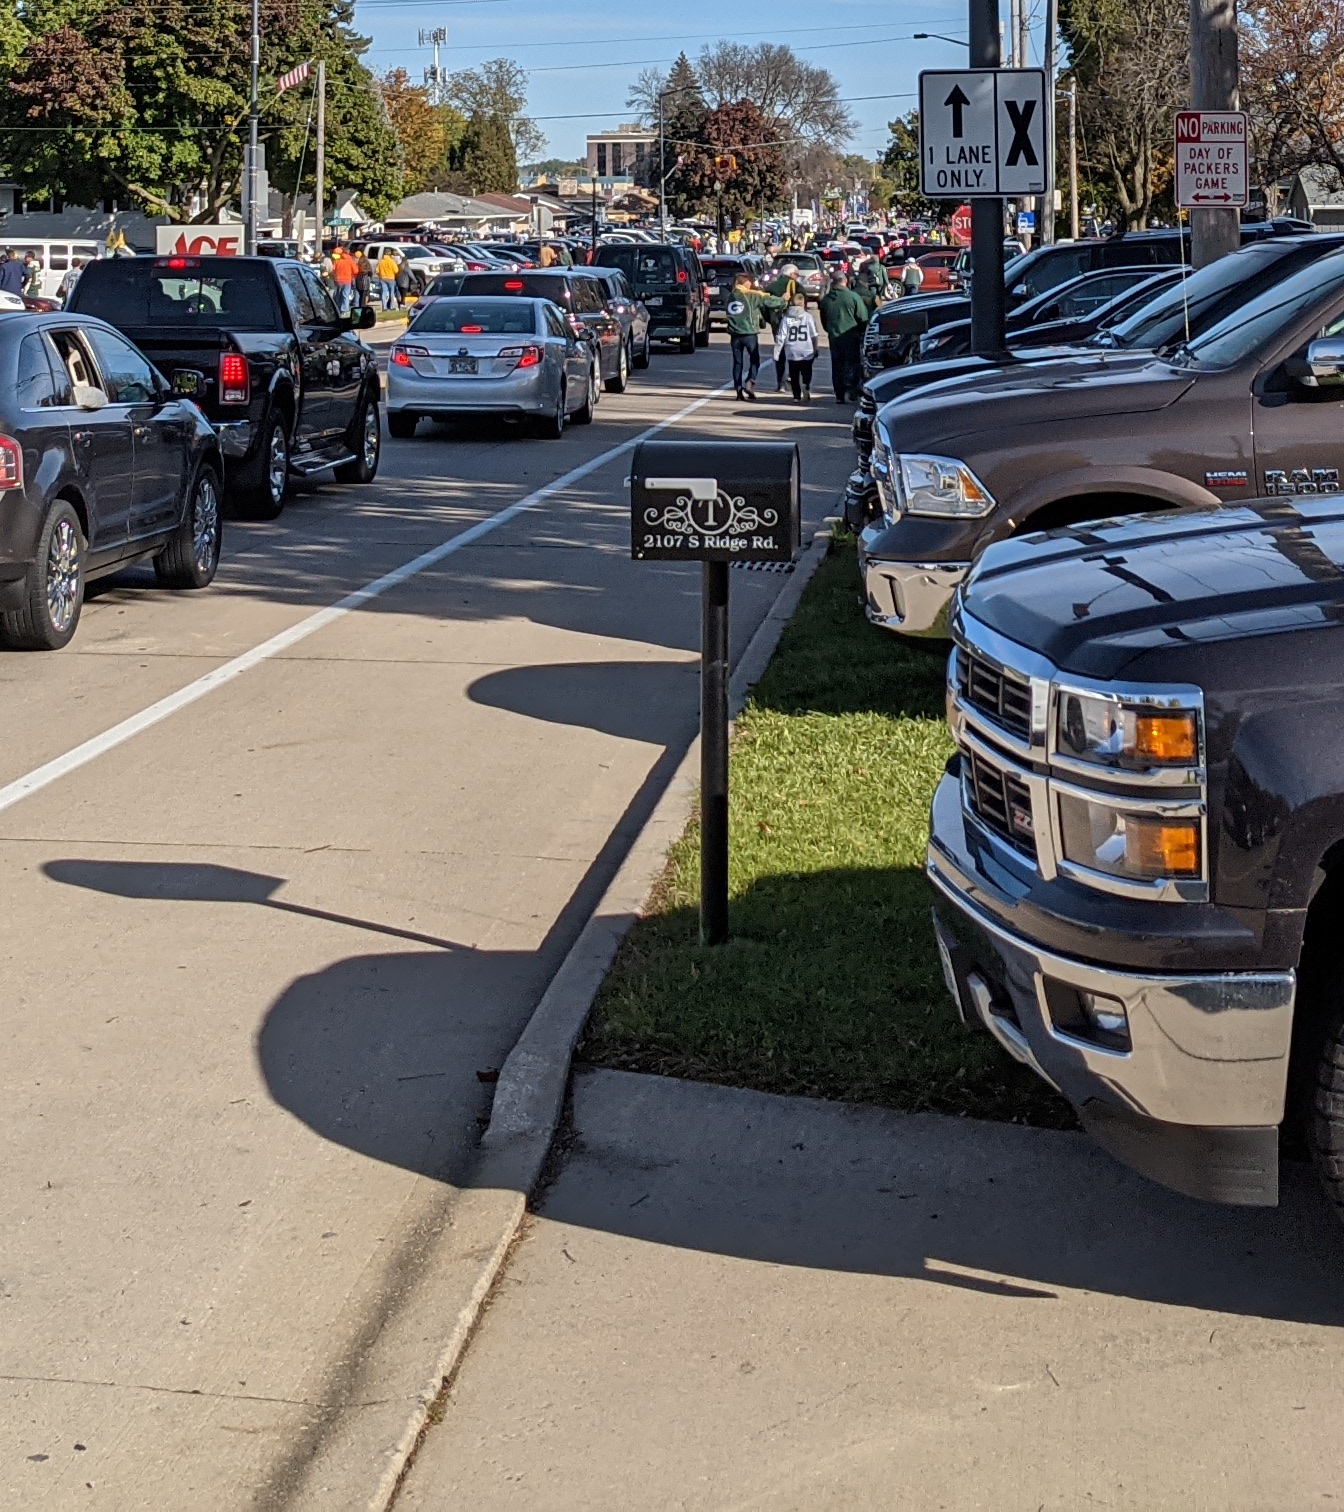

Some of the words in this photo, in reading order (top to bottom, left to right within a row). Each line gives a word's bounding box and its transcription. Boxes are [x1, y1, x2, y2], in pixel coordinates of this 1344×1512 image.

[1177, 117, 1199, 138] NO
[1202, 121, 1243, 134] PARKING
[928, 145, 934, 165] 1
[946, 145, 992, 165] LANE
[1189, 147, 1211, 160] DAY
[1217, 147, 1233, 160] OF
[1184, 162, 1239, 175] PACKERS
[937, 169, 983, 188] ONLY
[1196, 177, 1228, 190] GAME
[956, 217, 972, 229] ST
[168, 232, 240, 256] ACE
[788, 325, 808, 342] 85
[1264, 467, 1340, 484] RAM
[1265, 482, 1340, 496] 1500
[643, 535, 683, 548] 2107
[688, 535, 700, 548] S
[704, 535, 748, 551] Ridge
[752, 536, 779, 549] Rd.
